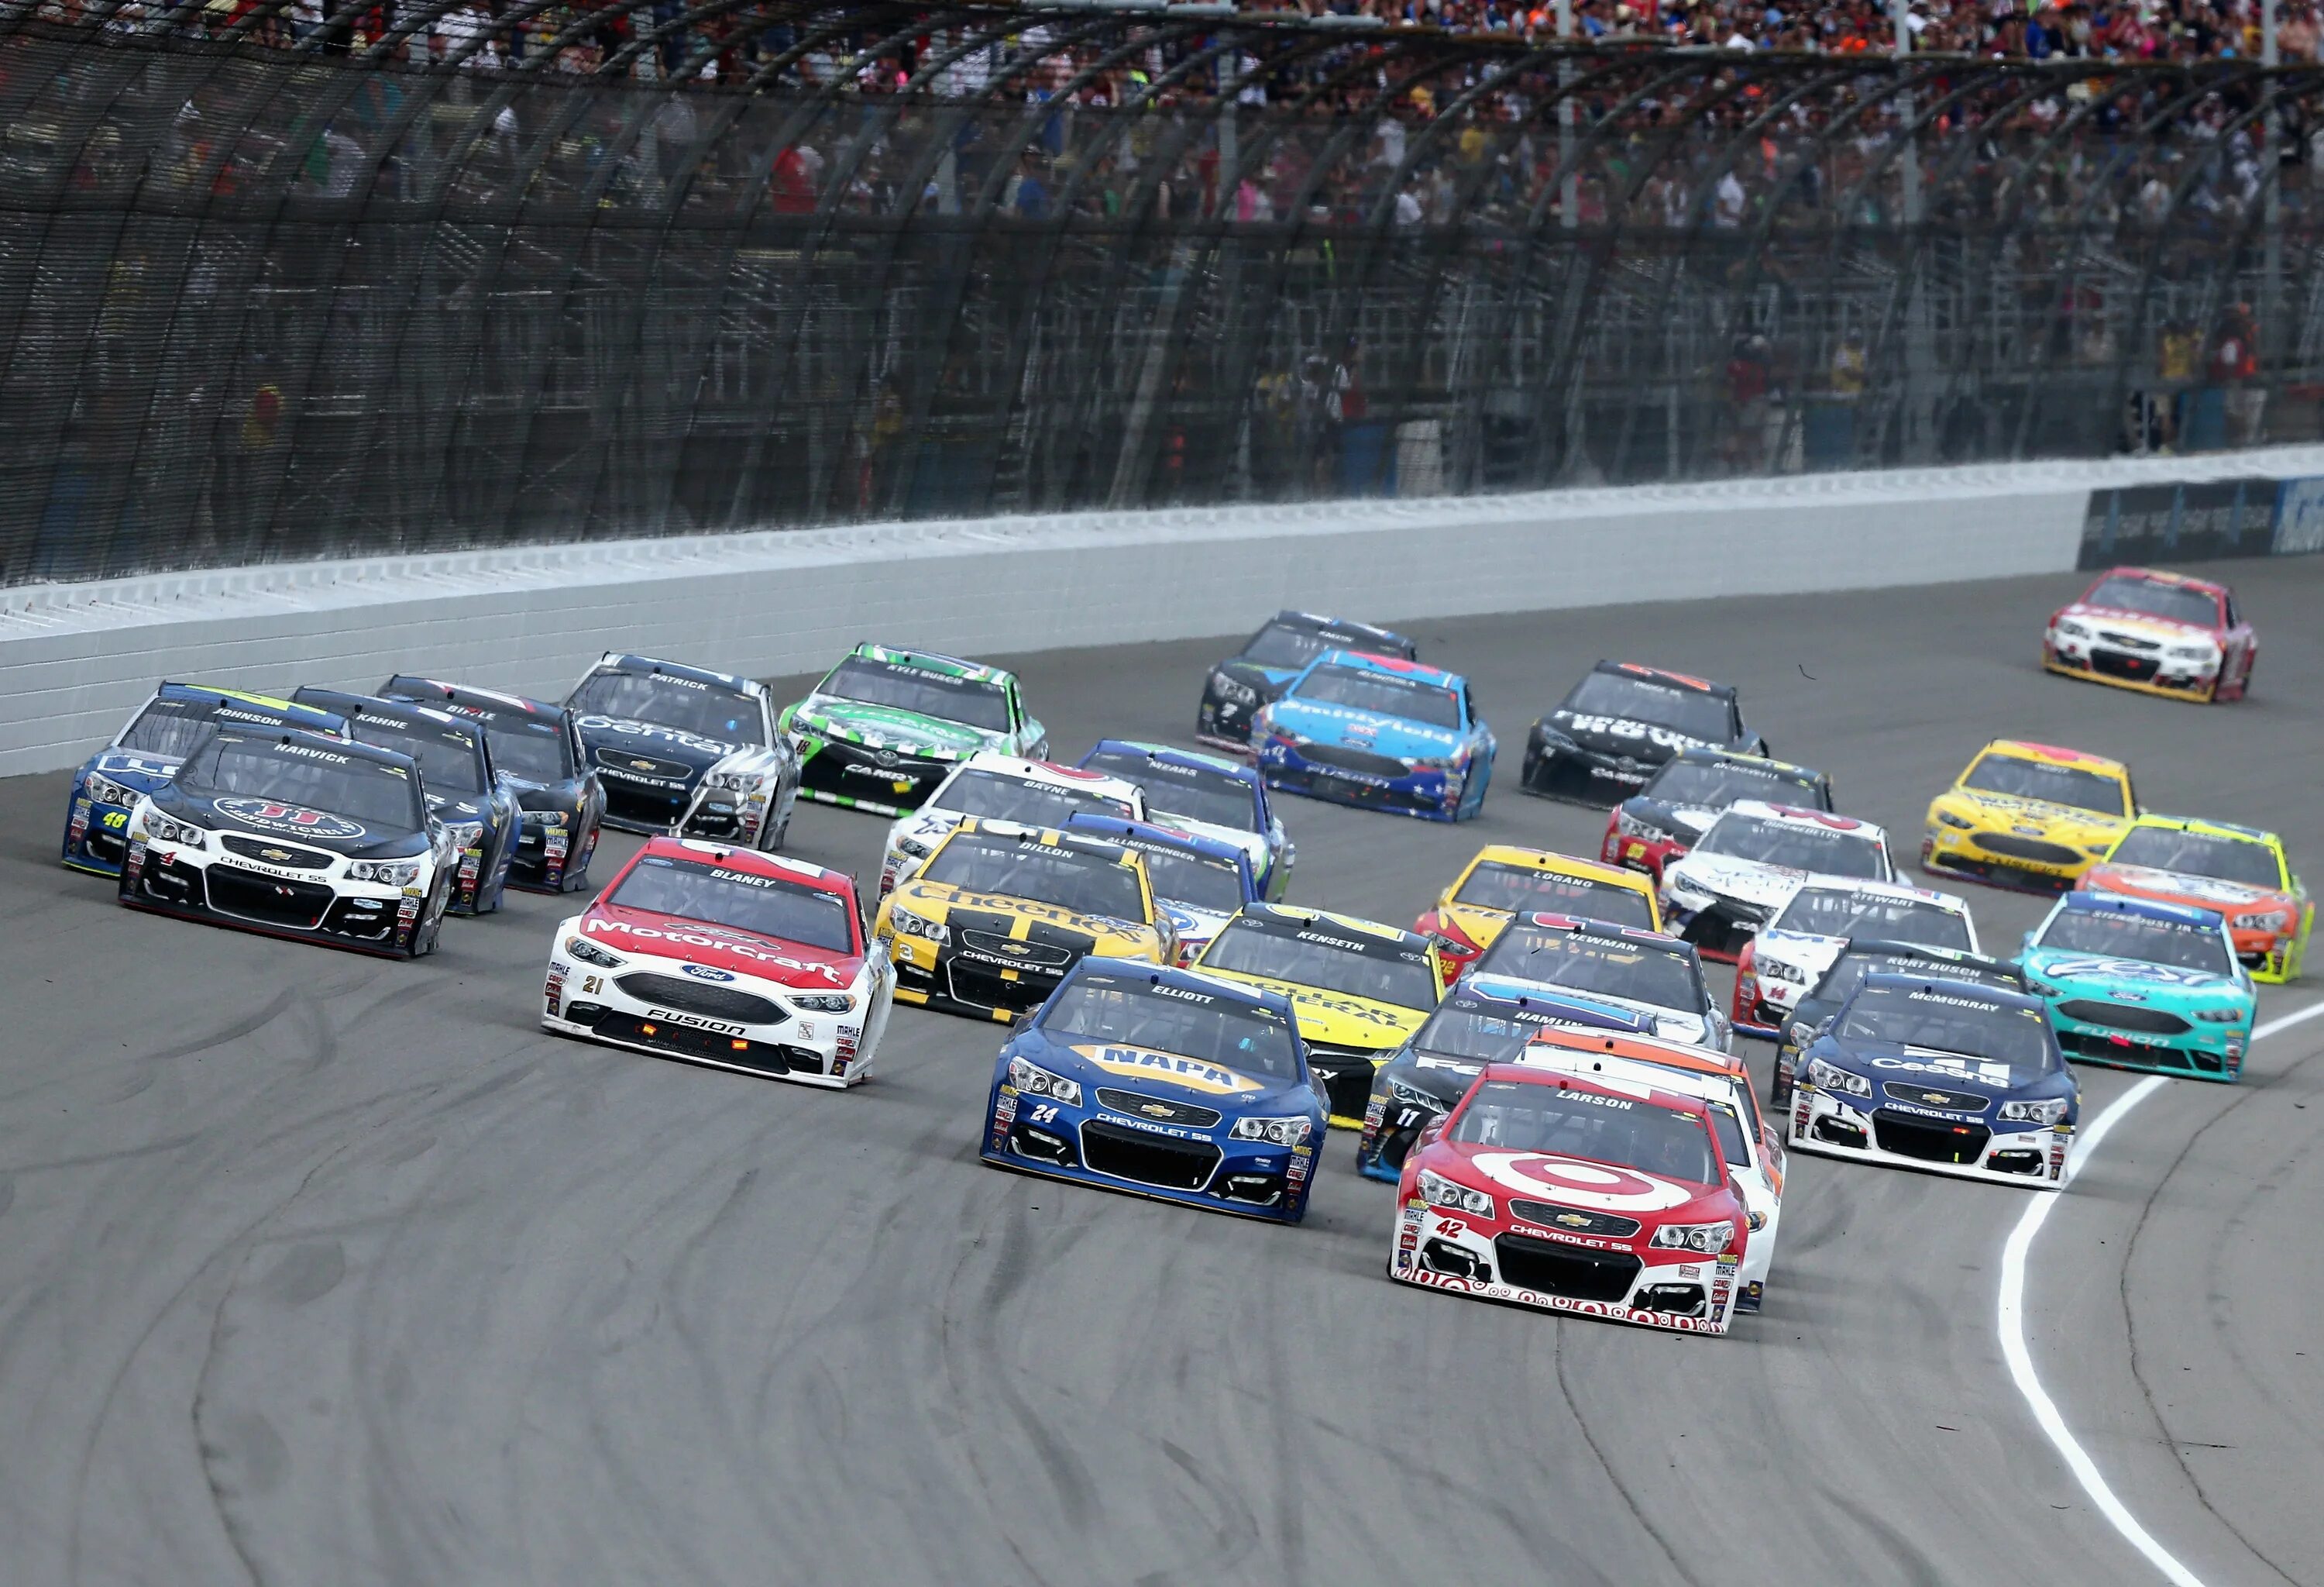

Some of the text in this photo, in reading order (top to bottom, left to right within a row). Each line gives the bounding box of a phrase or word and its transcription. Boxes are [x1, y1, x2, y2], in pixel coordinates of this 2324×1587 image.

[648, 673, 708, 690] PATRICK
[920, 670, 963, 685] BUSCH
[213, 707, 283, 726] JOHNSON
[356, 713, 408, 730] KAHNE
[273, 743, 350, 765] HARVICK
[596, 766, 686, 791] CHEVROLET SS
[1023, 780, 1071, 796] BAYNE
[101, 811, 127, 828] 48
[160, 852, 177, 866] 4
[1019, 841, 1074, 859] DILLON
[1105, 837, 1196, 862] ALLMENDINGER
[211, 855, 304, 881] CHEVROLET
[710, 868, 776, 888] BLANEY
[1532, 870, 1593, 888] LOGANO
[1851, 891, 1915, 908] STEWART
[909, 885, 1142, 943] Cheerios
[2092, 910, 2172, 930] STENHOUSE
[586, 917, 843, 985] Motorcraft
[1296, 930, 1366, 952] KENSETH
[1566, 932, 1639, 952] NEWMAN
[898, 943, 914, 961] 3
[549, 962, 570, 976] MAHLE
[962, 949, 1064, 976] CHEVROLET SS
[1886, 956, 1982, 979] KURT BUSCH
[690, 966, 726, 981] Ford
[583, 975, 604, 995] 21
[1151, 985, 1215, 1004] ELLIOTT
[1908, 991, 1999, 1013] McMURRAY
[646, 1009, 747, 1036] FUSION
[1514, 1010, 1583, 1028] HAMLIN
[837, 1025, 860, 1038] MAHLE
[2073, 1025, 2170, 1048] FUSION
[1103, 1048, 1233, 1086] NAPA
[1871, 1056, 2010, 1089] Cessna
[1556, 1089, 1634, 1110] LARSON
[1835, 1101, 1844, 1117] 1
[1030, 1104, 1059, 1124] 24
[1397, 1108, 1421, 1127] 11
[1884, 1101, 1985, 1124] CHEVROLET SS
[1096, 1113, 1212, 1142] CHEVROLET SS
[1404, 1210, 1425, 1222] MAHLE
[1435, 1217, 1466, 1239] 42
[1510, 1224, 1633, 1252] CHEVROLET SS
[1716, 1265, 1735, 1276] MAHLE
